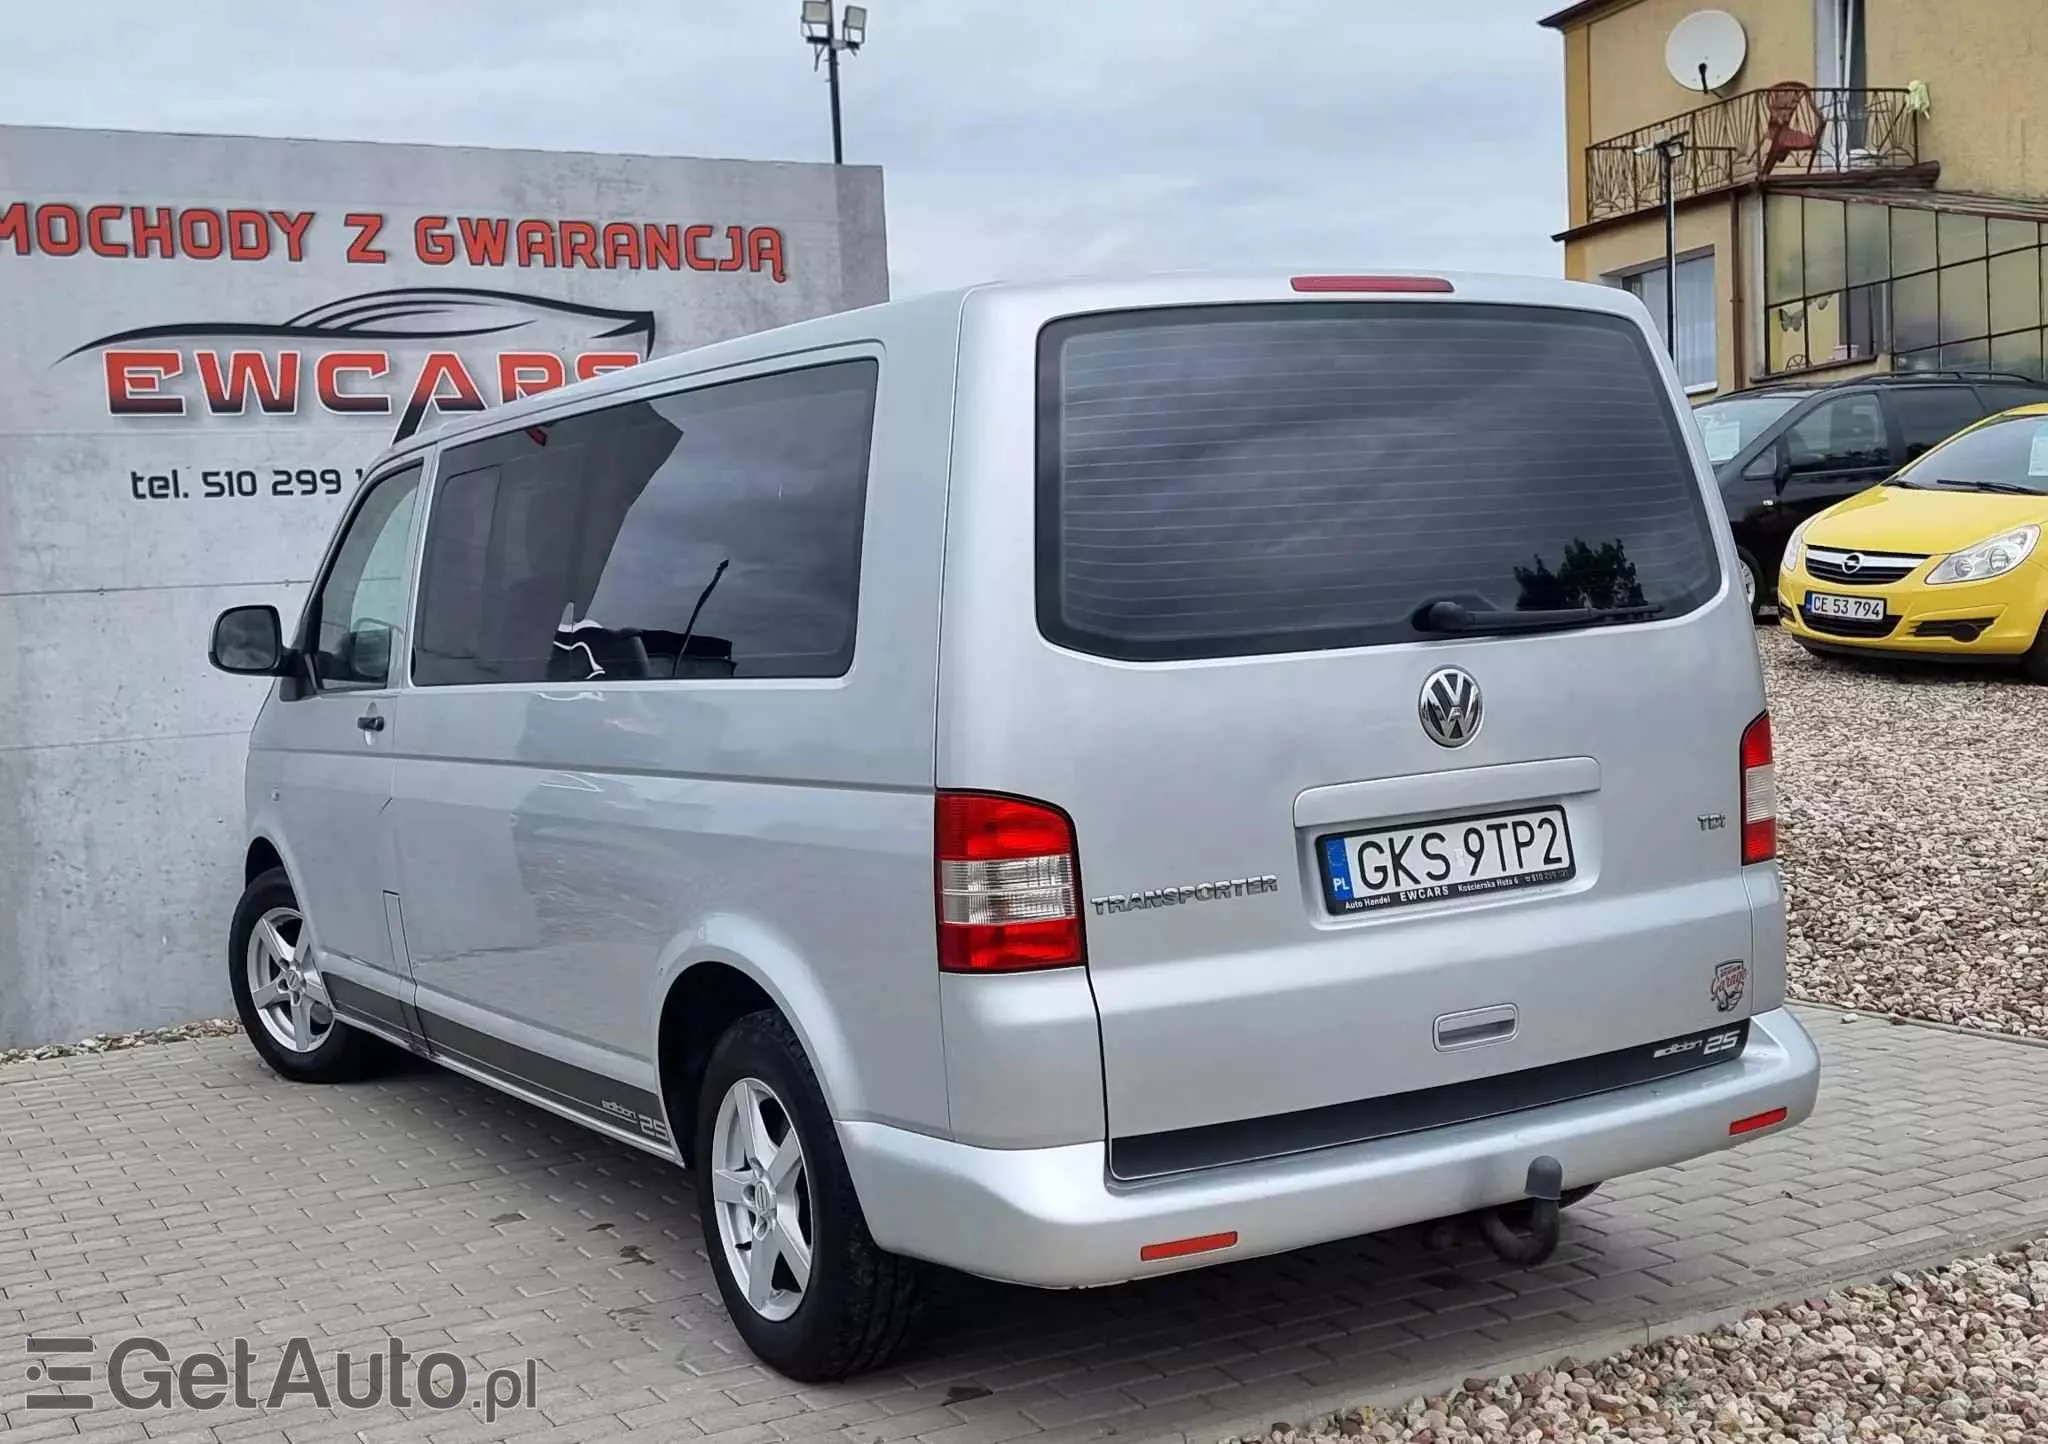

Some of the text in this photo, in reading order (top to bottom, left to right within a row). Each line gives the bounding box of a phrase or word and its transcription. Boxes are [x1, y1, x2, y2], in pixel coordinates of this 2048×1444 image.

[344, 213, 388, 264] Z
[414, 215, 786, 284] GWARANCJĄ
[130, 469, 189, 499] tel.
[201, 470, 257, 497] 510
[271, 468, 341, 496] 299
[1813, 596, 1881, 618] CE 53 794
[1357, 817, 1563, 890] GKS 9TP2
[1090, 874, 1278, 916] TRANSPORTER
[1333, 877, 1350, 891] PL
[1345, 900, 1363, 910] Auto
[1365, 895, 1391, 906] Handel
[1400, 886, 1449, 902] EWCARS
[1703, 1030, 1741, 1056] 25
[638, 1114, 669, 1141] 25
